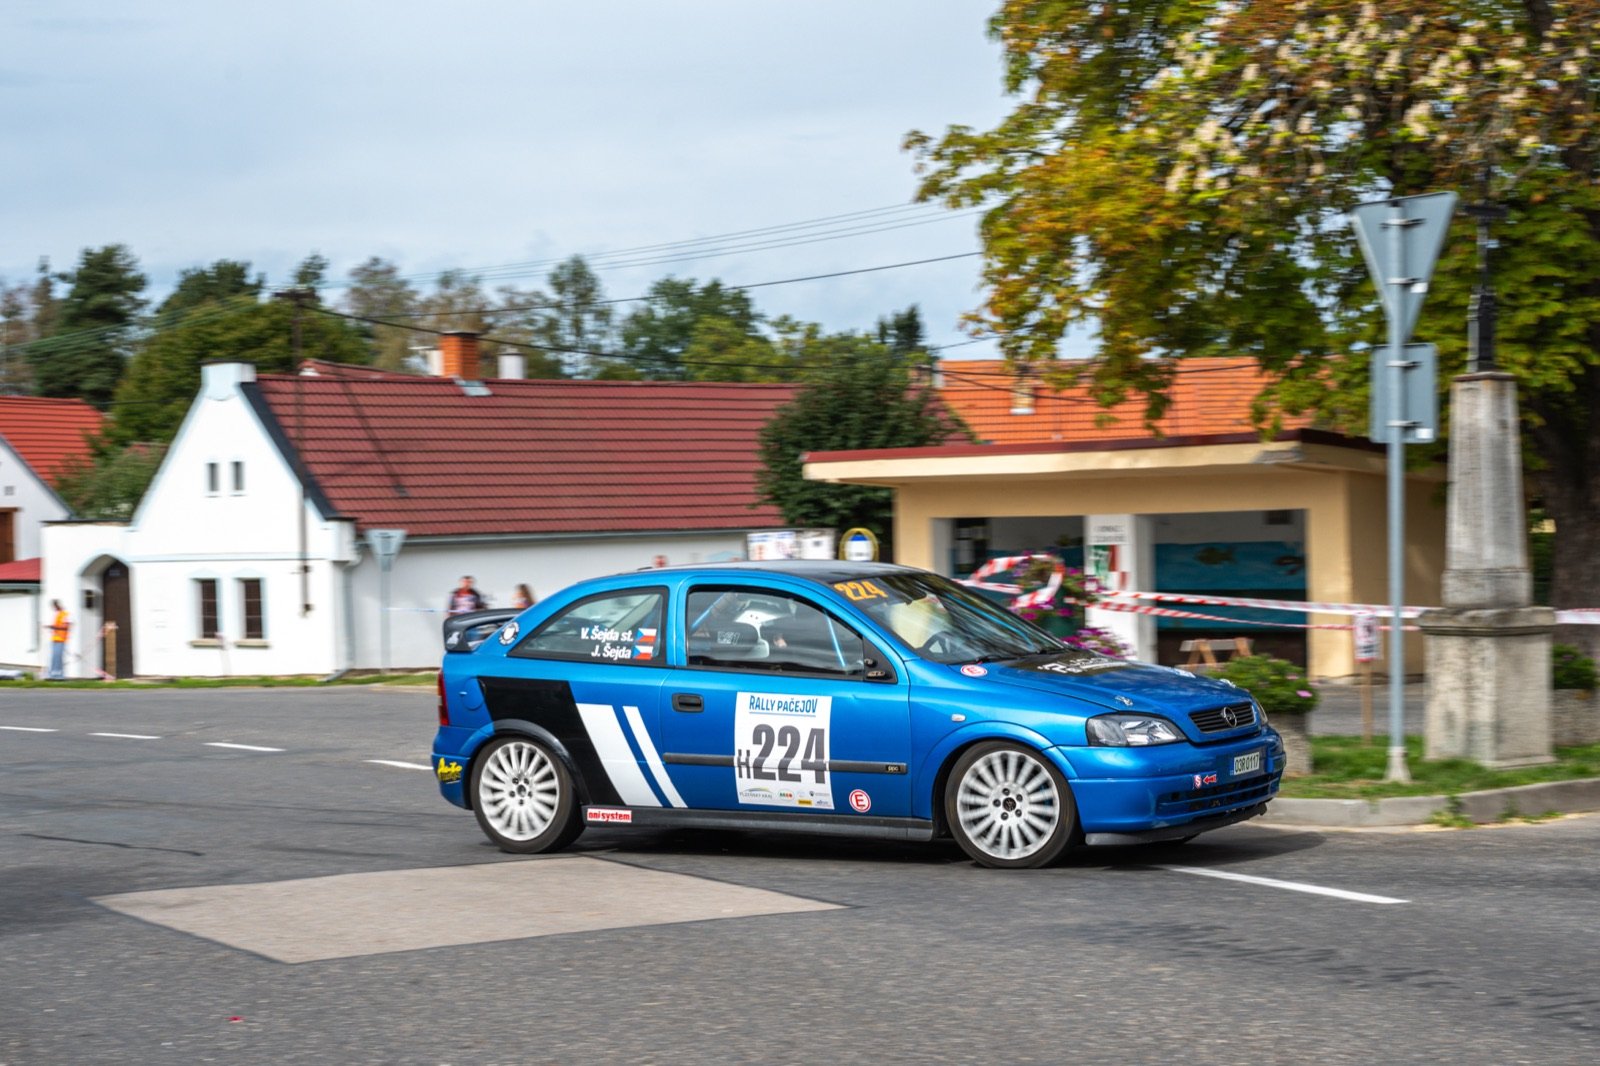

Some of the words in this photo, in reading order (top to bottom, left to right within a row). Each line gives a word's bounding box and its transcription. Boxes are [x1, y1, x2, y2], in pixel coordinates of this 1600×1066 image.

[834, 580, 888, 601] 224
[581, 627, 590, 640] V.
[591, 625, 619, 643] Šejda
[621, 630, 634, 642] st.
[591, 645, 601, 657] J.
[603, 643, 632, 660] Šejda
[749, 695, 775, 711] RALLY
[777, 698, 818, 713] PAČEJOV
[737, 749, 751, 779] H
[752, 723, 826, 784] 224
[854, 794, 866, 807] E
